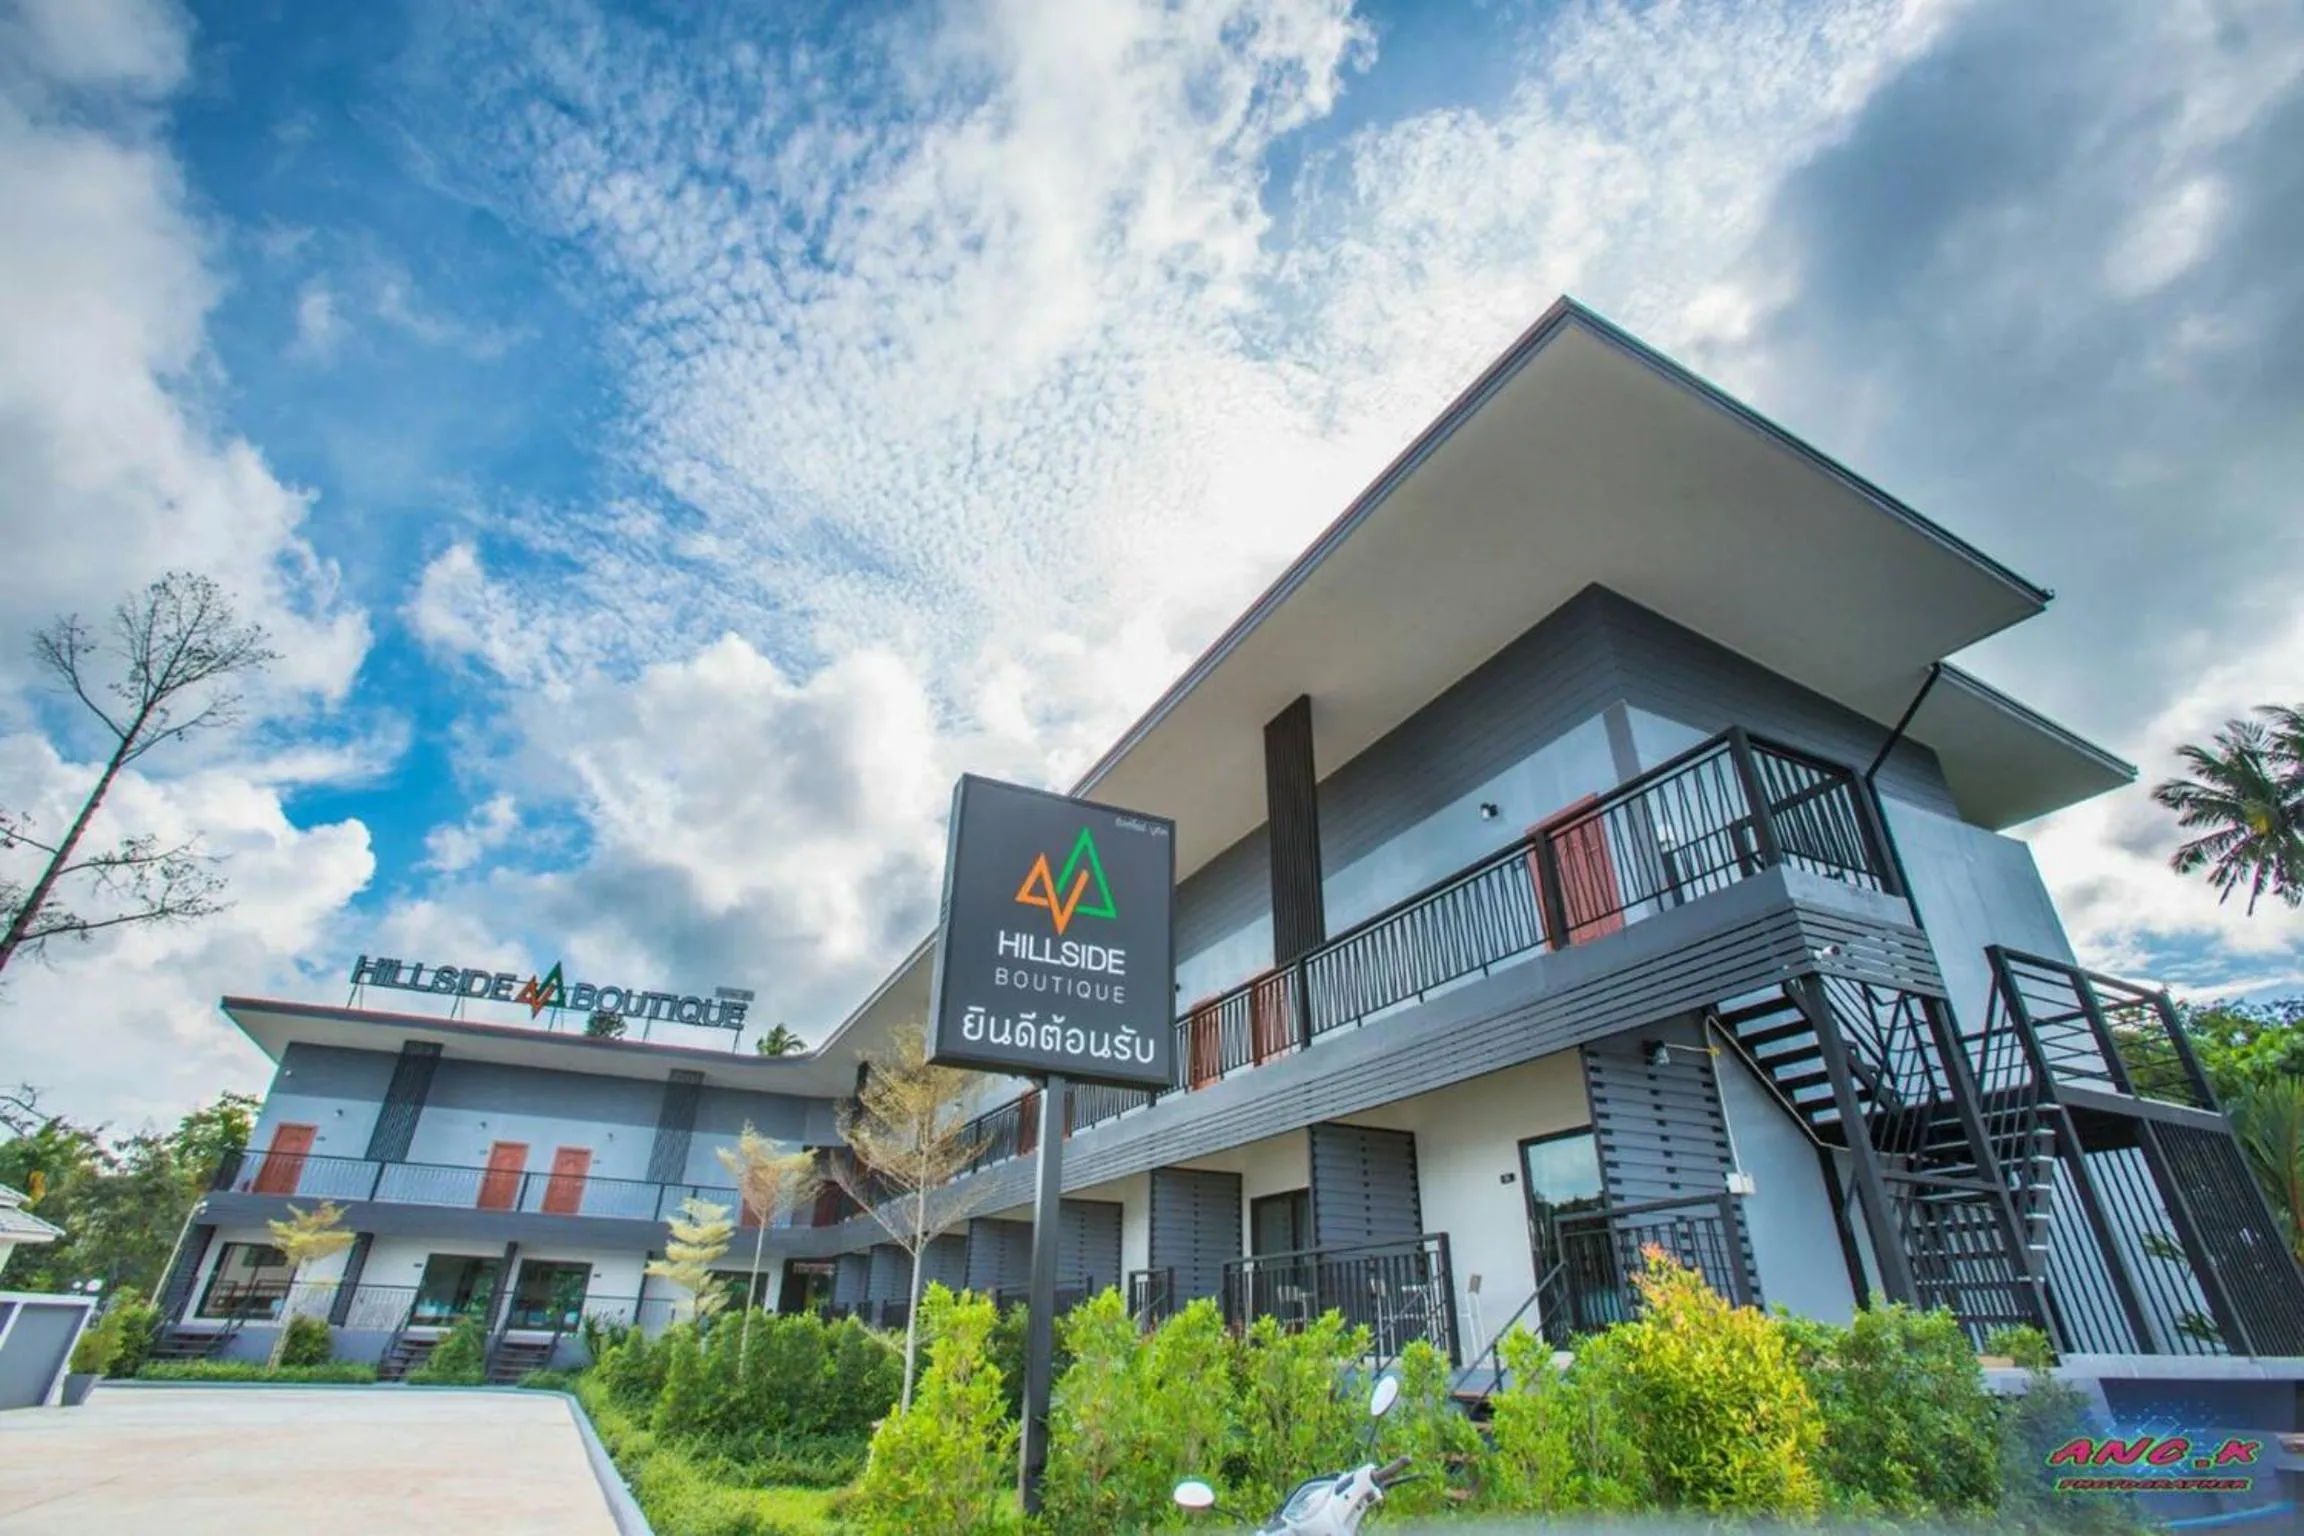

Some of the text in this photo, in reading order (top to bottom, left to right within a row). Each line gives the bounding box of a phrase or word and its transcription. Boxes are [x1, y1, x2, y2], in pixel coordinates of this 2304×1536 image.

[998, 930, 1126, 976] HILLSIDE
[350, 955, 749, 1031] HILLSIDE BOUTIQUE
[994, 966, 1126, 1005] BOUTIQUE
[962, 1005, 1156, 1064] ยินดีต้อนรับ
